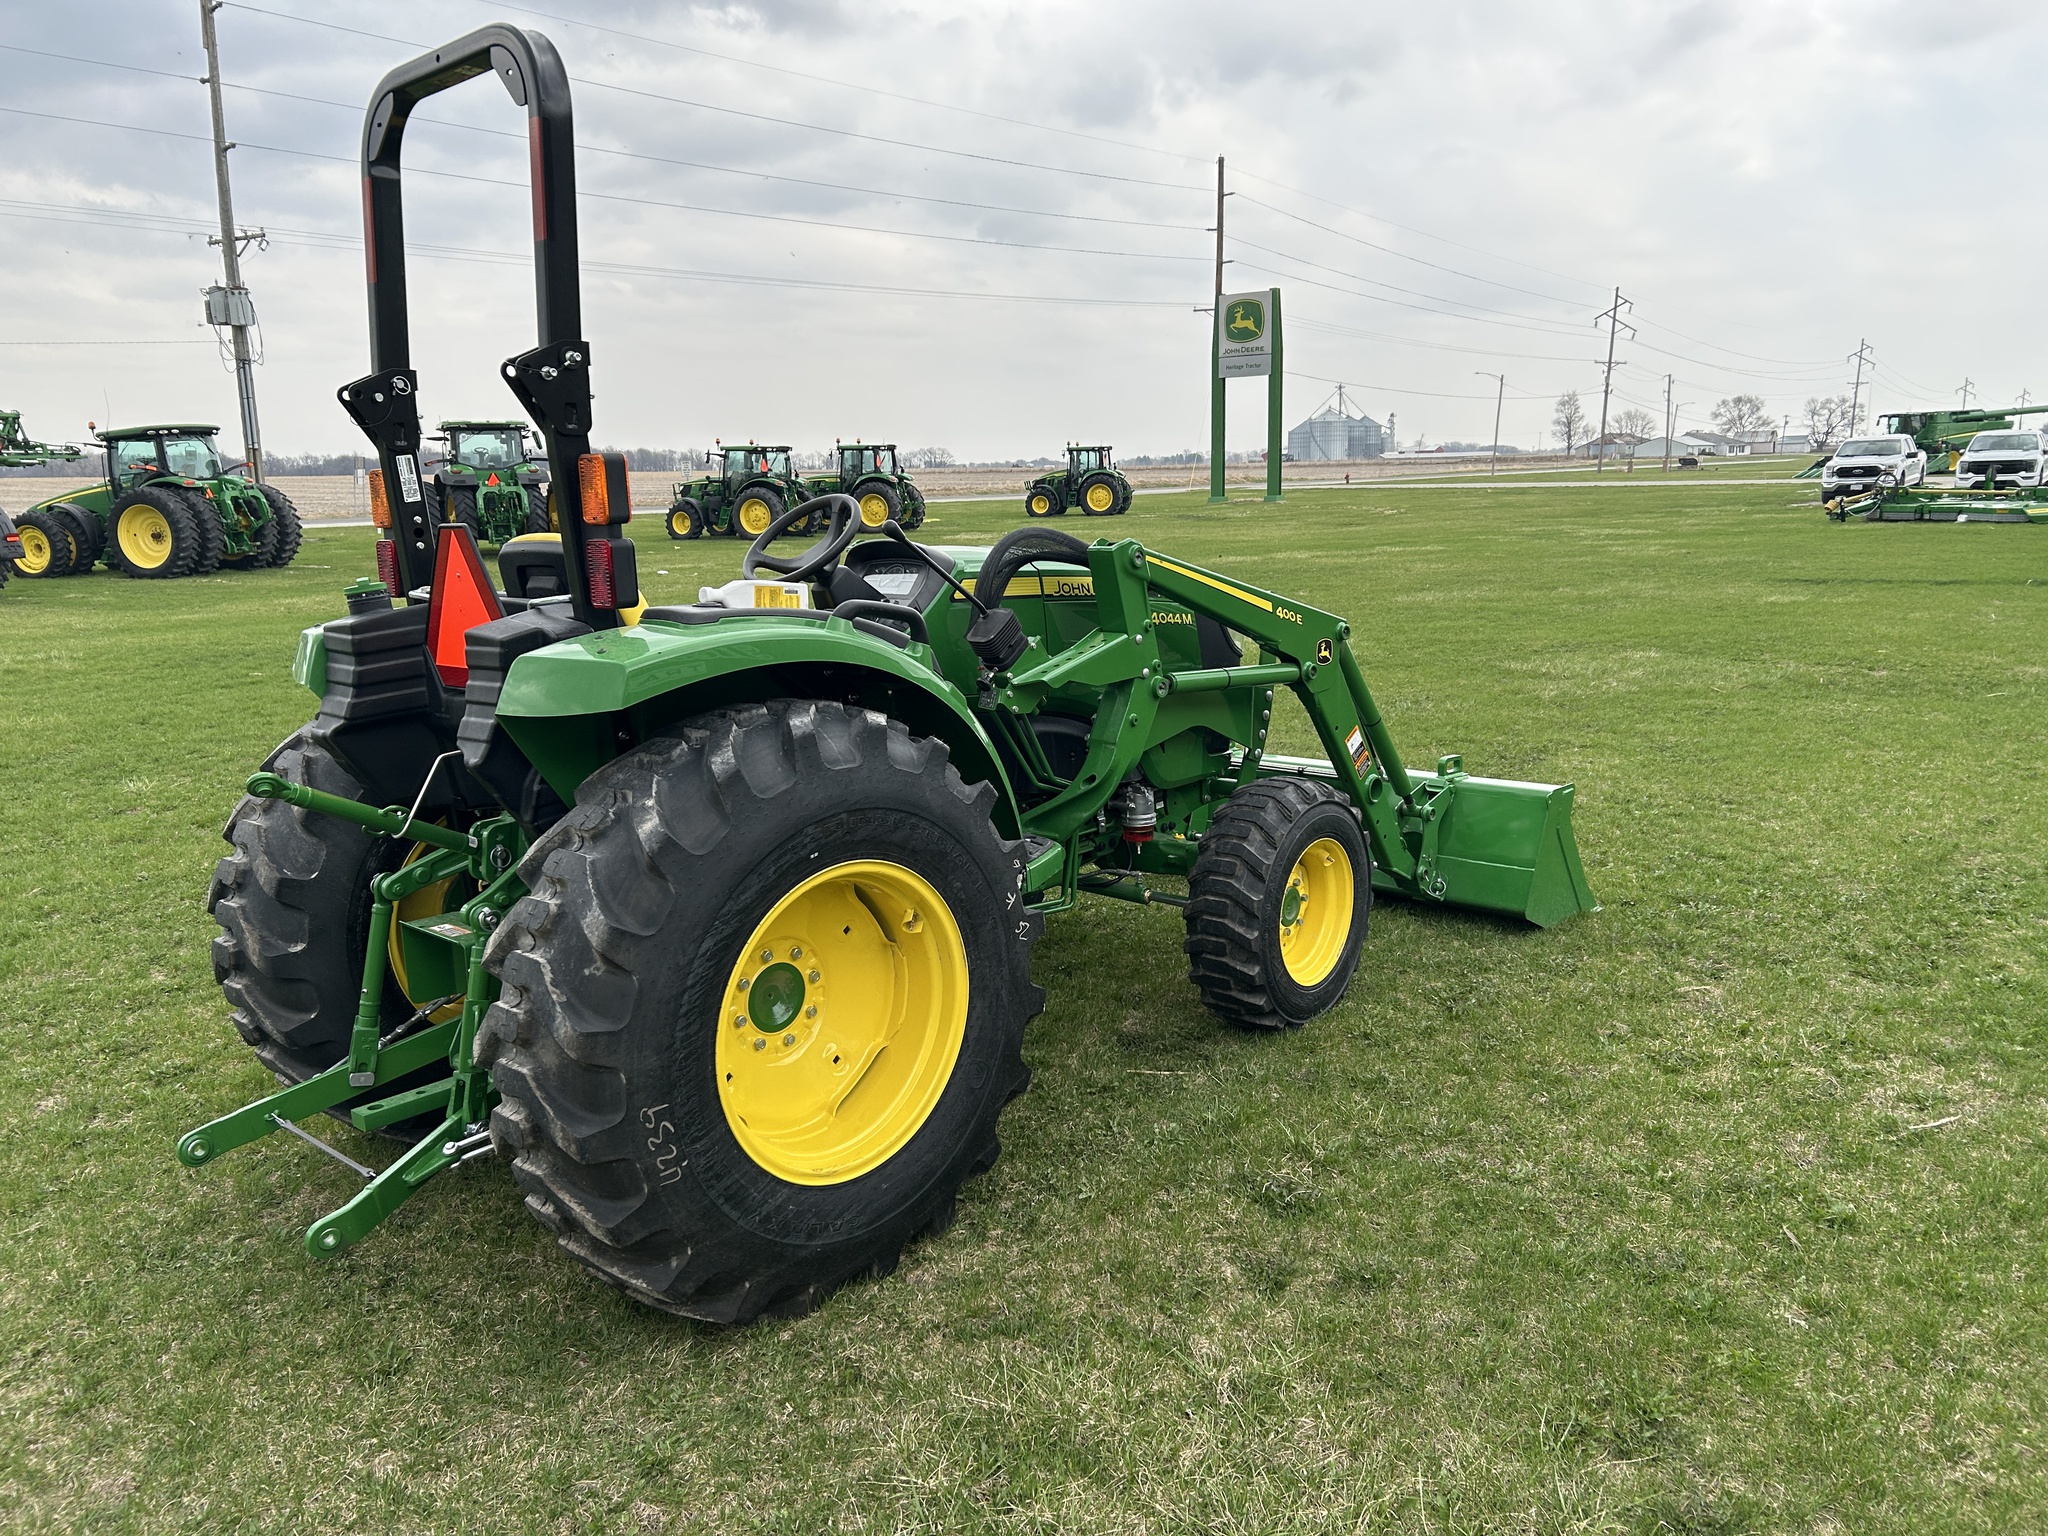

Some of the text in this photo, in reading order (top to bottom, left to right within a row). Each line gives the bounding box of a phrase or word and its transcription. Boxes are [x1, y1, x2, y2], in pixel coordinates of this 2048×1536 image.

[1054, 580, 1091, 595] JOHN
[1151, 612, 1193, 625] 4044M
[640, 1104, 688, 1187] 4239
